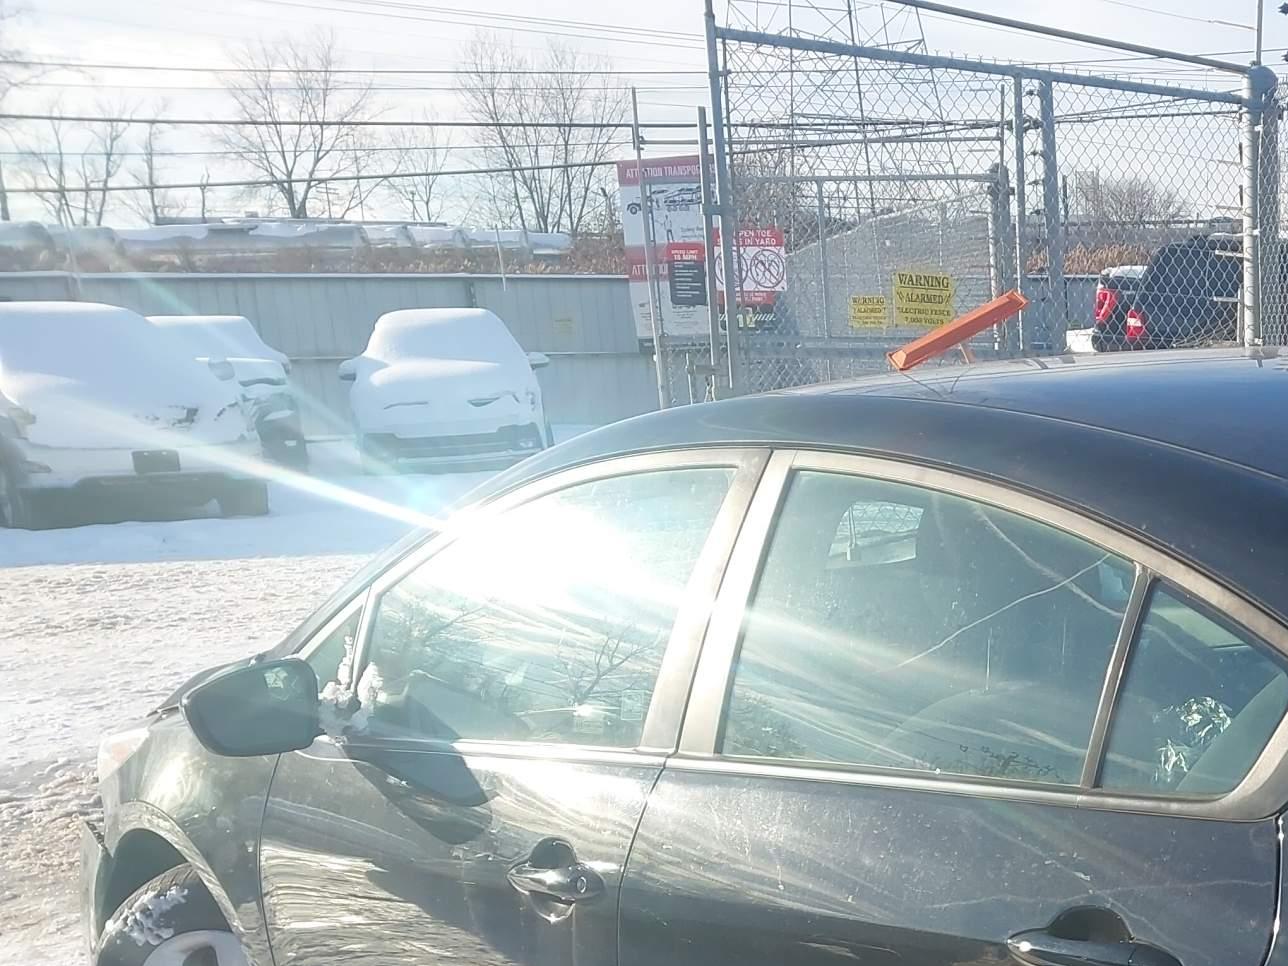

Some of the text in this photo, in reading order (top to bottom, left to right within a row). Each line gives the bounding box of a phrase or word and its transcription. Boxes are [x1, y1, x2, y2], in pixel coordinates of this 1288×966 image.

[755, 238, 777, 246] YARD
[898, 273, 950, 289] WARNING
[906, 292, 944, 304] ALARMED
